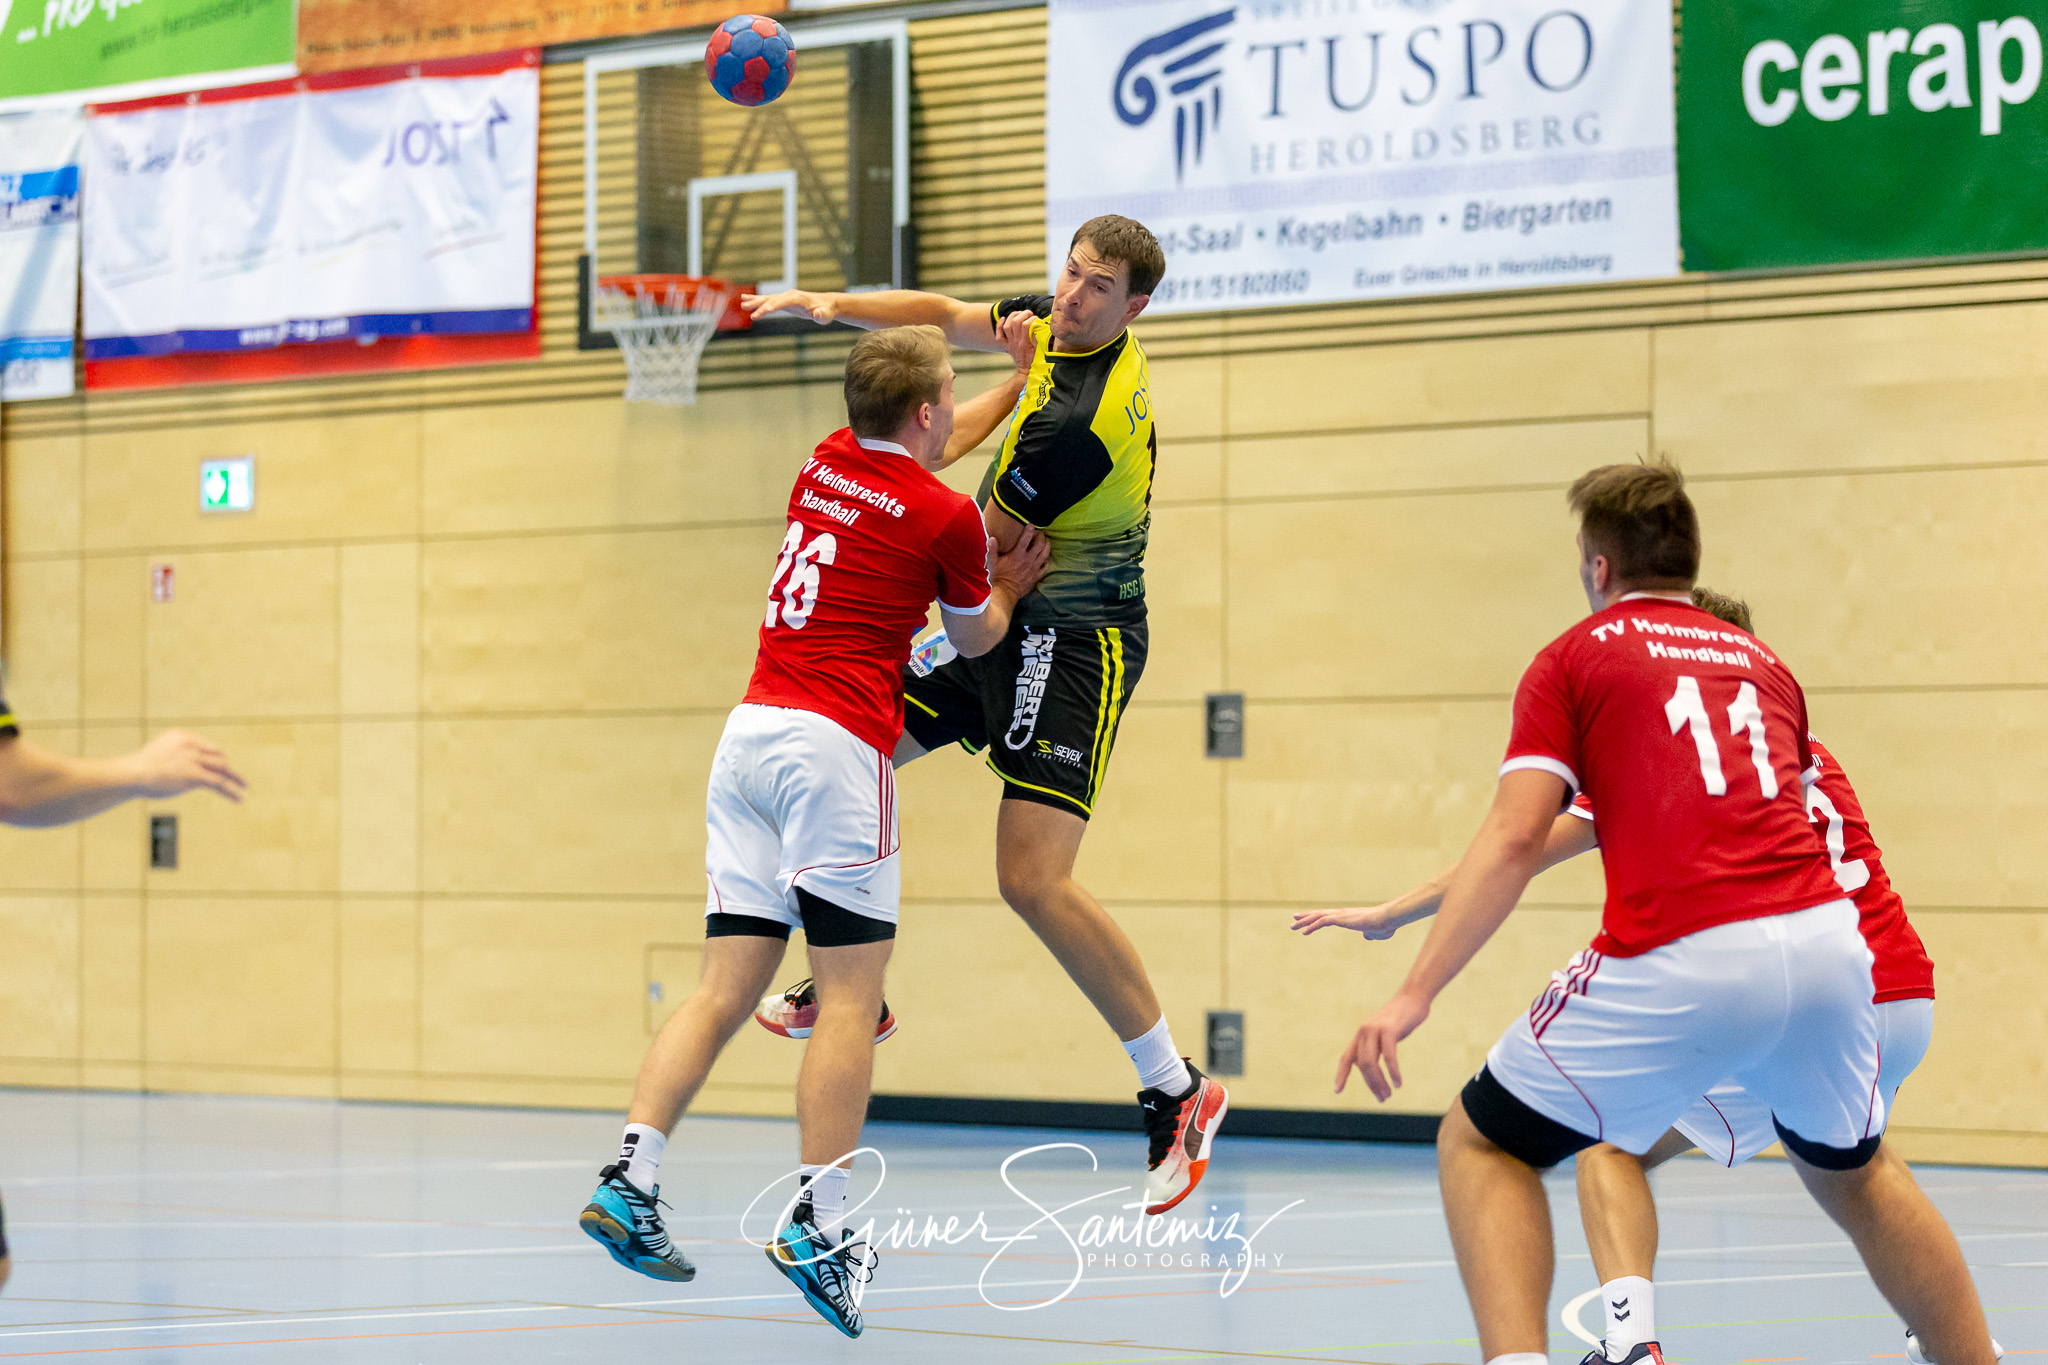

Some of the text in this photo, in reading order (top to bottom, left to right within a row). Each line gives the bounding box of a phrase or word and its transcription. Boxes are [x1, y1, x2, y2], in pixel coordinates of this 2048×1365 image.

[1245, 9, 1594, 119] TUSPO
[1742, 15, 2043, 135] cerap
[1250, 111, 1603, 174] HEROLDSBERG
[1276, 209, 1423, 252] Kegelbahn
[1463, 196, 1613, 235] Biergarten
[1353, 265, 1395, 289] Euer
[1476, 259, 1491, 277] in
[1498, 253, 1613, 276] Heroldsberg
[799, 488, 861, 526] Handball
[812, 464, 906, 518] Helmbrechts
[765, 520, 837, 630] 26
[1119, 579, 1139, 601] HSG
[1591, 619, 1624, 642] TV
[1645, 641, 1752, 669] Handball
[1008, 633, 1043, 733] MEIER
[1020, 633, 1057, 732] ROBERT
[1055, 745, 1083, 762] SEVEN
[1664, 675, 1779, 800] 11
